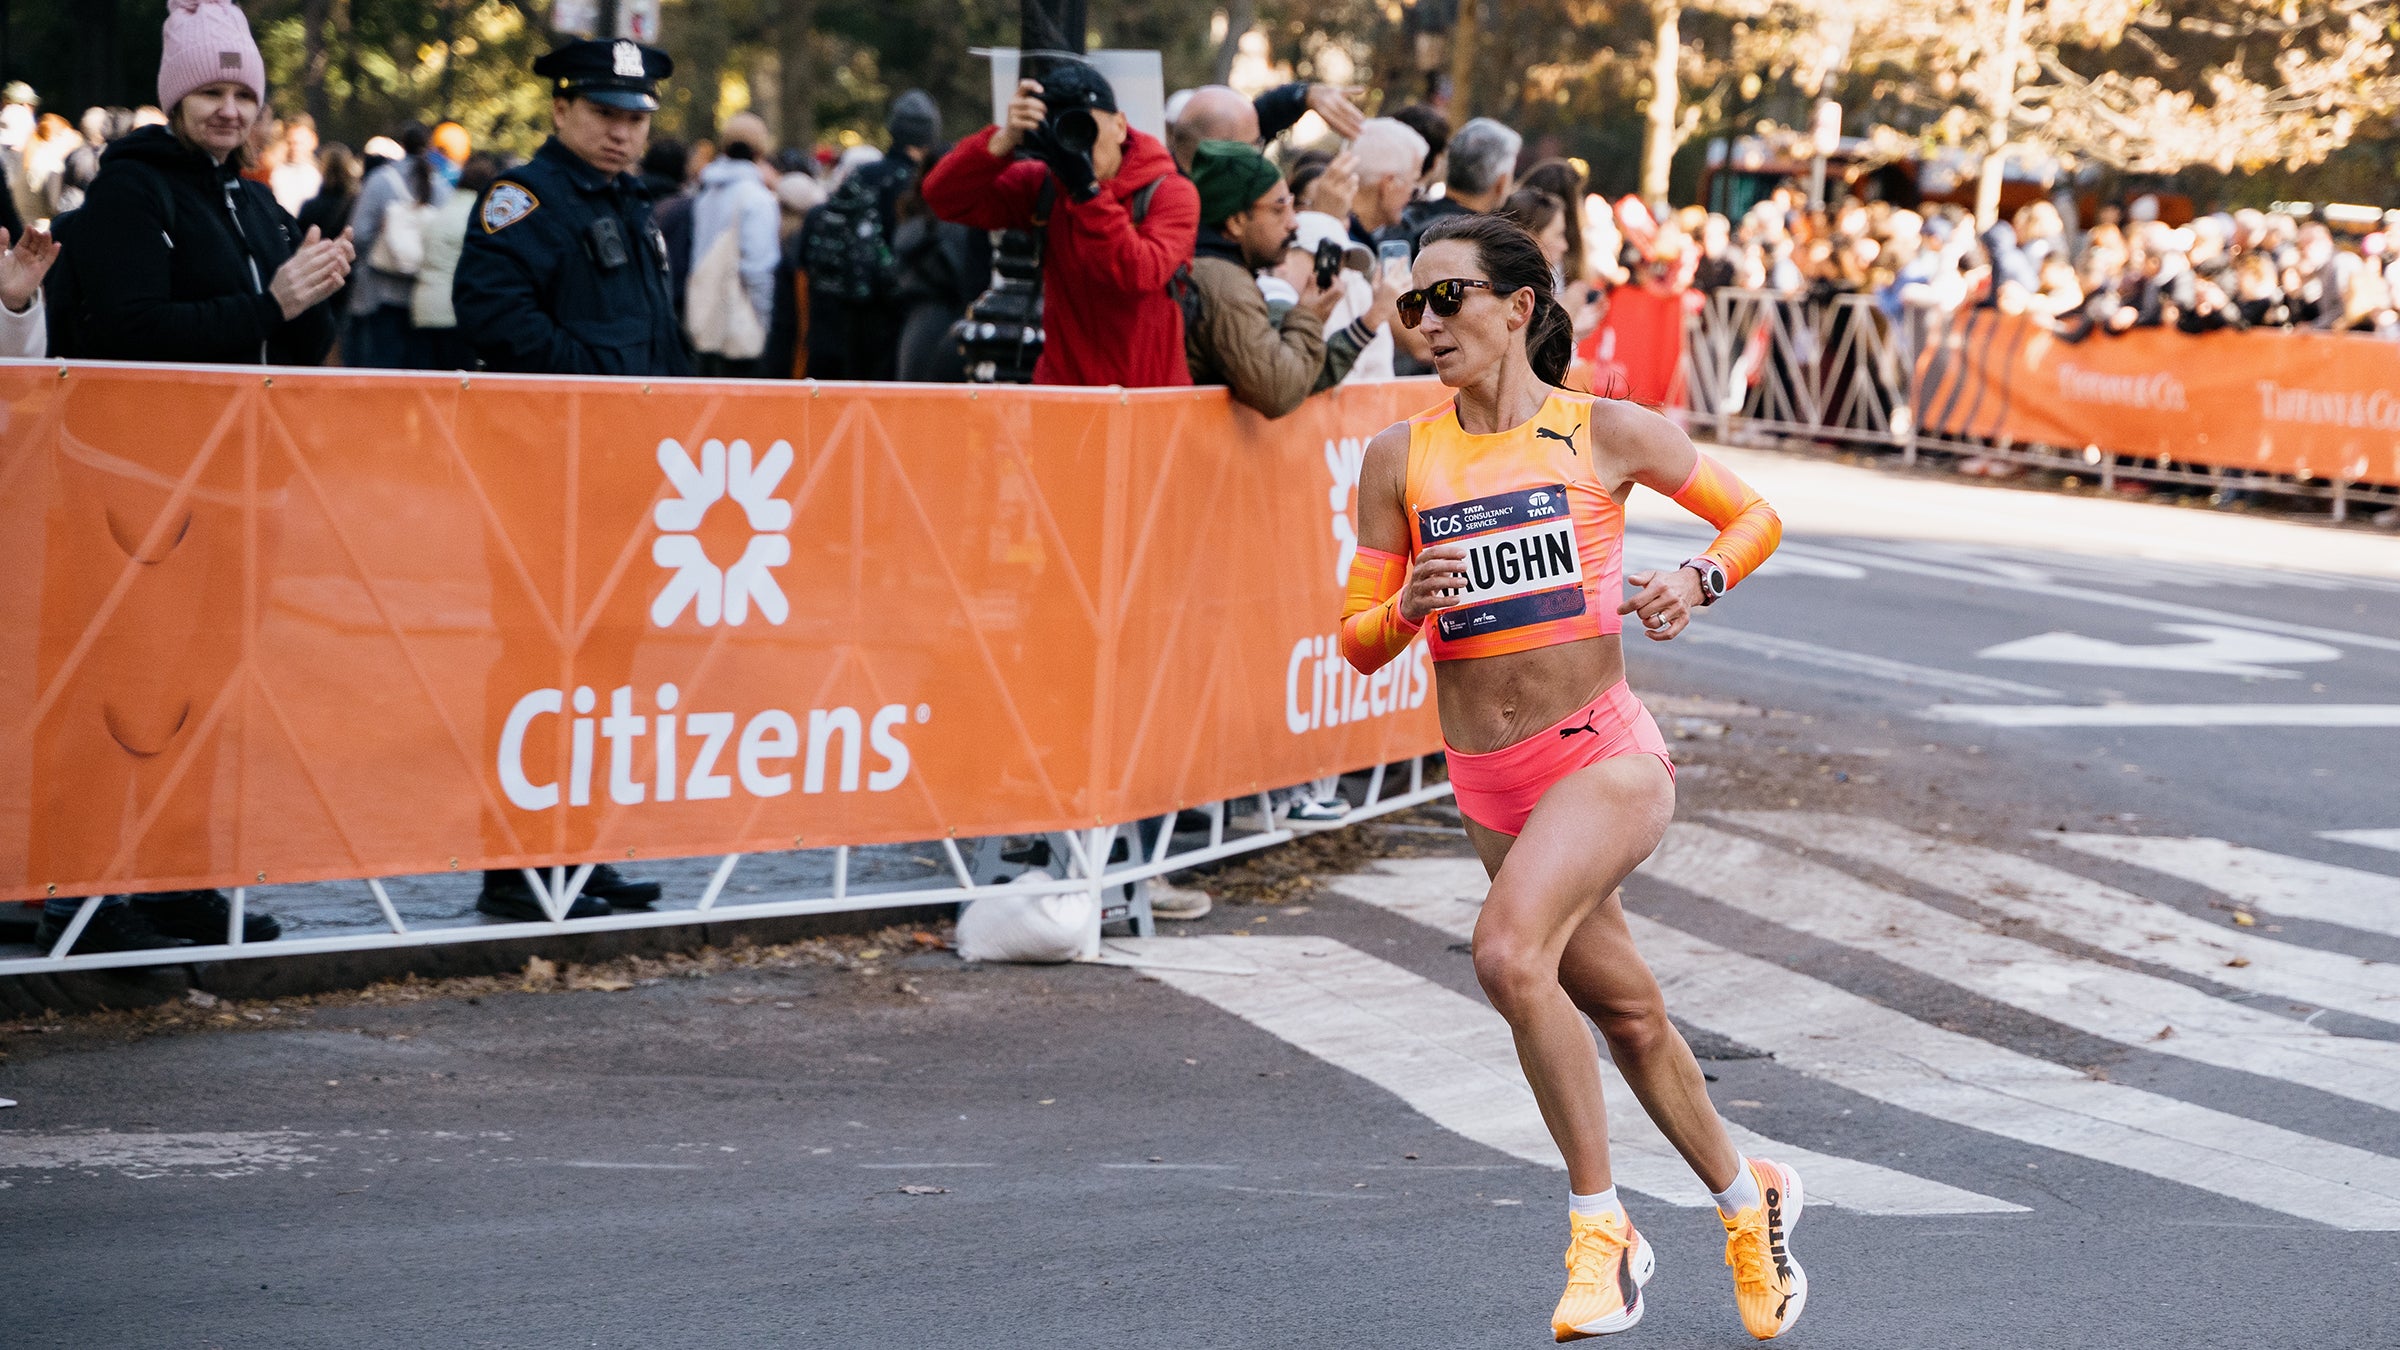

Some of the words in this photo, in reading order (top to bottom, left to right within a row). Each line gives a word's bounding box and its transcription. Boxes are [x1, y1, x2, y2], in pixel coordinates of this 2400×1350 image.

[1463, 505, 1484, 514] TATA
[1464, 506, 1513, 522] CONSULTANCY
[1528, 506, 1555, 517] TATA
[1429, 514, 1463, 538] tcs
[1465, 518, 1498, 531] SERVICES
[1765, 1187, 1797, 1287] NITRO
